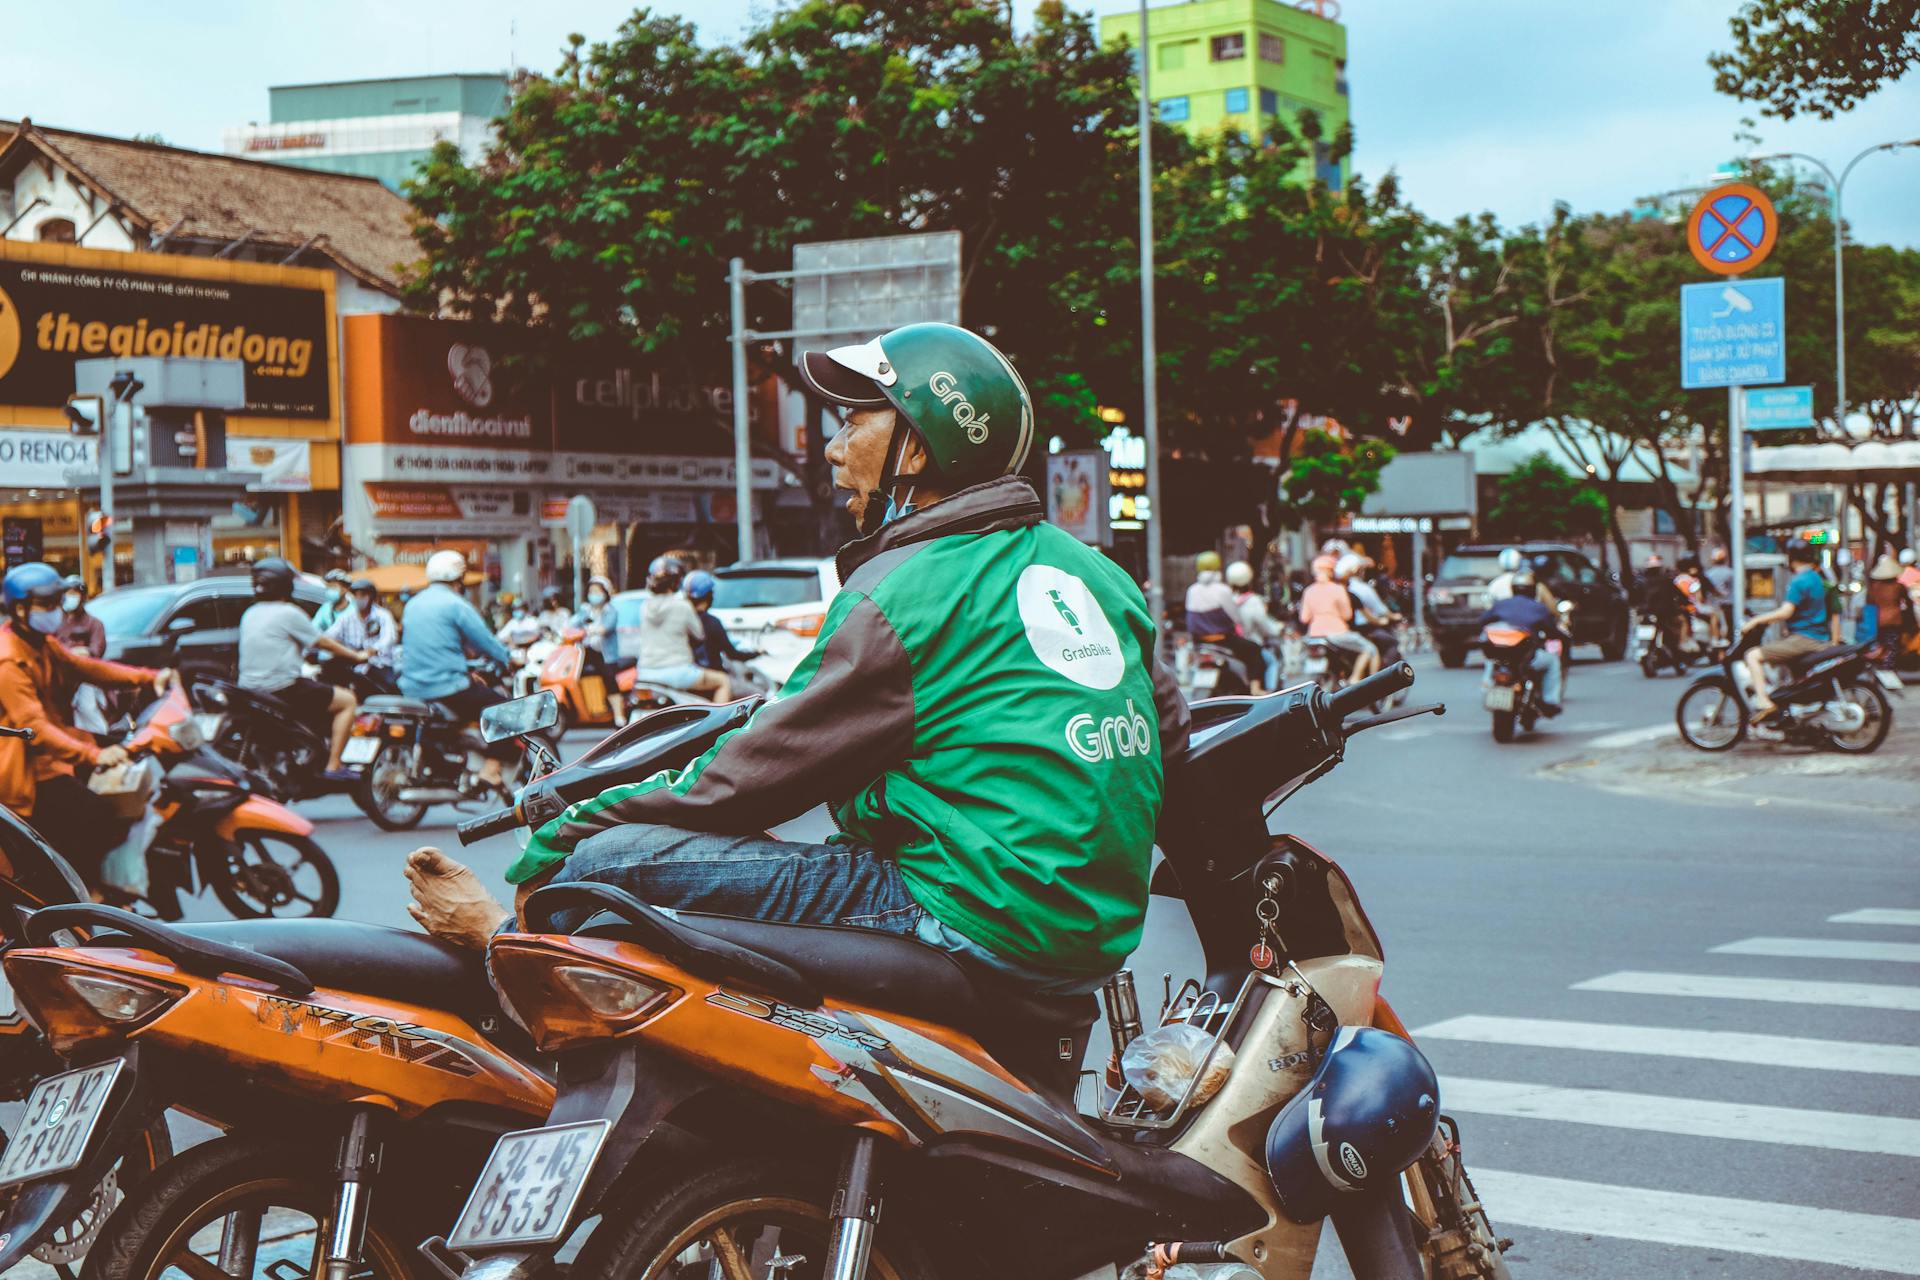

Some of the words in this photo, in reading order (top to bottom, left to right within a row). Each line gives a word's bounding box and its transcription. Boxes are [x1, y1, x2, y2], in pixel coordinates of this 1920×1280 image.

[37, 312, 312, 377] thegioididong
[409, 409, 532, 437] dienthoaivui
[929, 371, 990, 444] Grab
[20, 438, 89, 463] RENO4
[1062, 643, 1112, 662] GrabBike
[1065, 698, 1150, 763] Grab
[31, 1070, 105, 1127] 51N2
[7, 1120, 82, 1176] 2890
[500, 1131, 589, 1184] 34-N5
[470, 1183, 564, 1239] 9553
